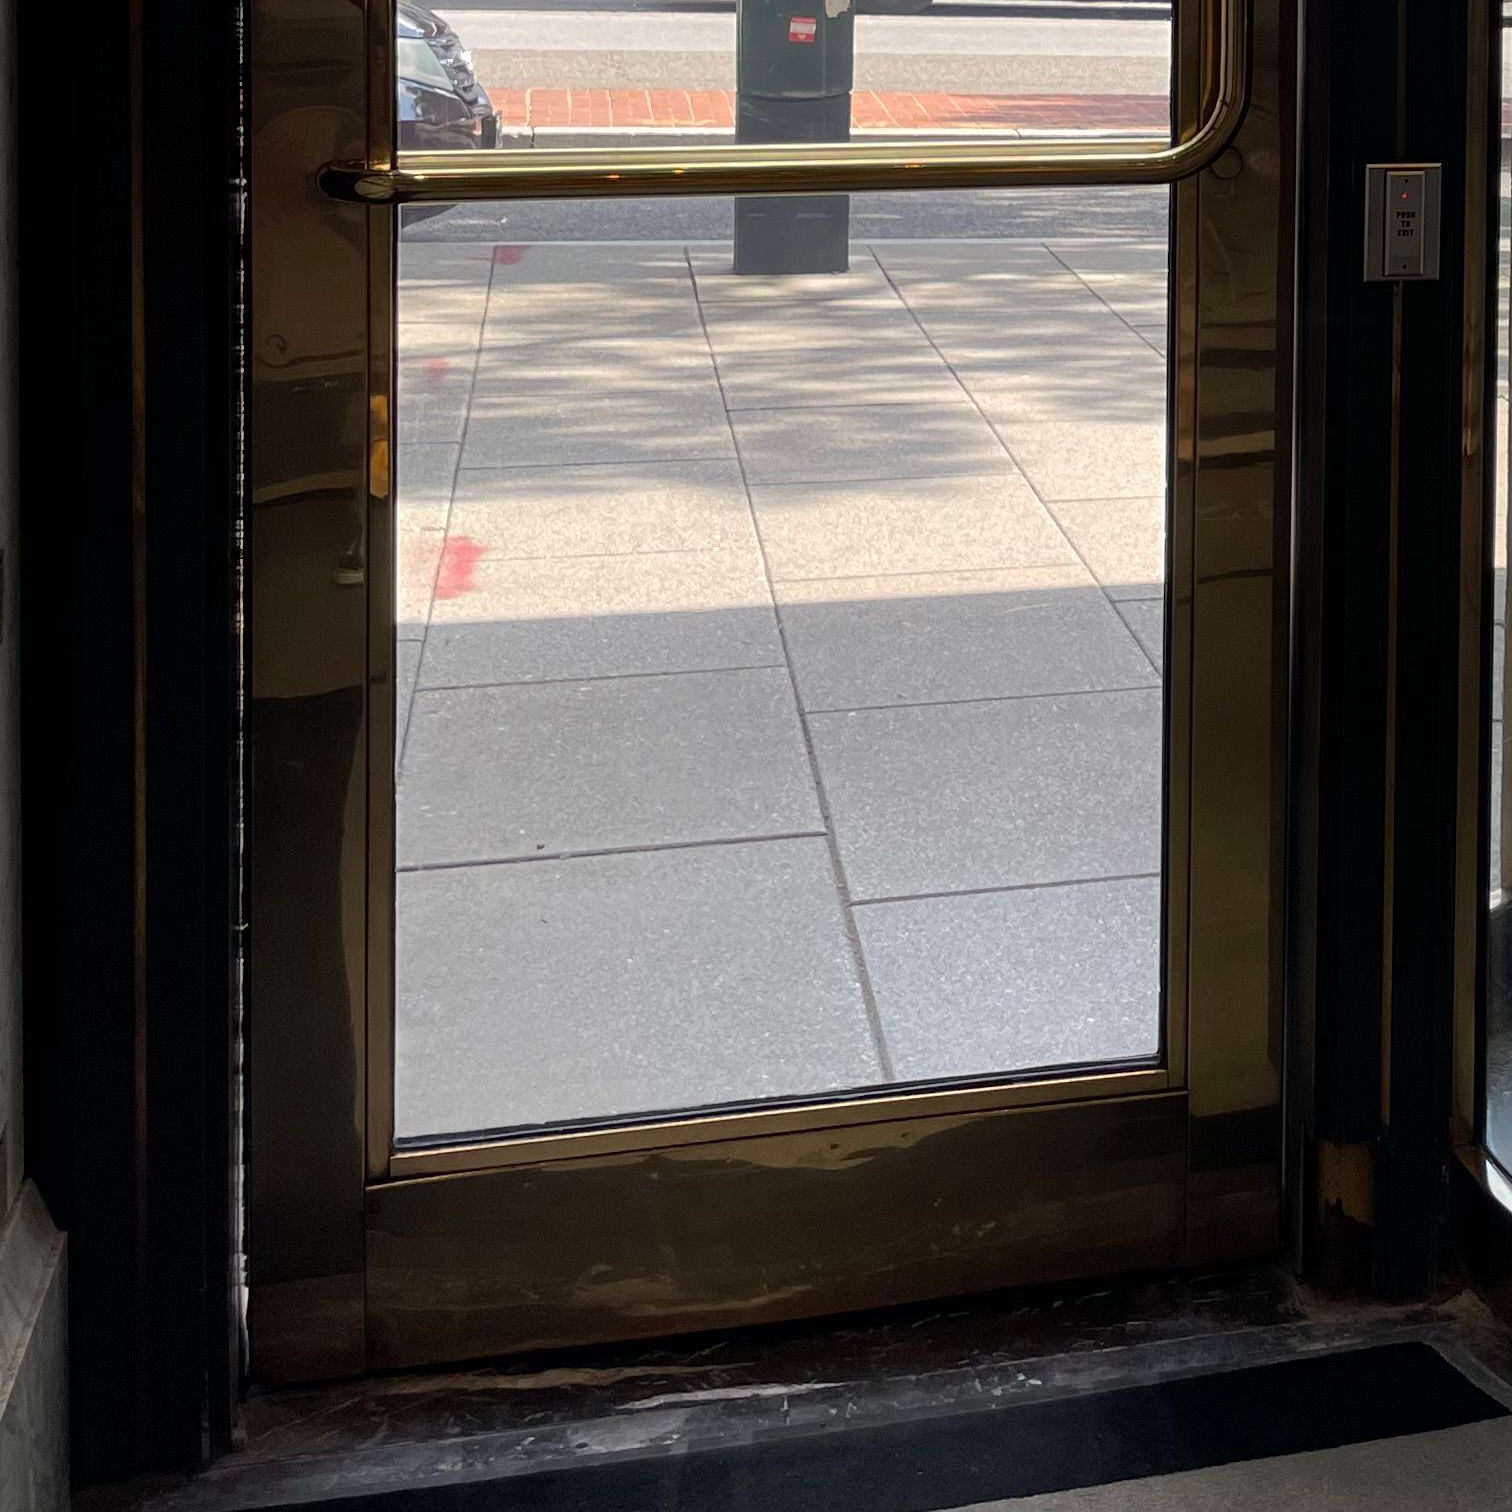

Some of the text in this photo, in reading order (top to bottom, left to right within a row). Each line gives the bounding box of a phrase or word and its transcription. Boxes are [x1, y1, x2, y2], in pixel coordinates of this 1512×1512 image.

[1396, 211, 1416, 219] PUSH
[1401, 220, 1411, 228] TO
[1397, 229, 1414, 237] EXIT
